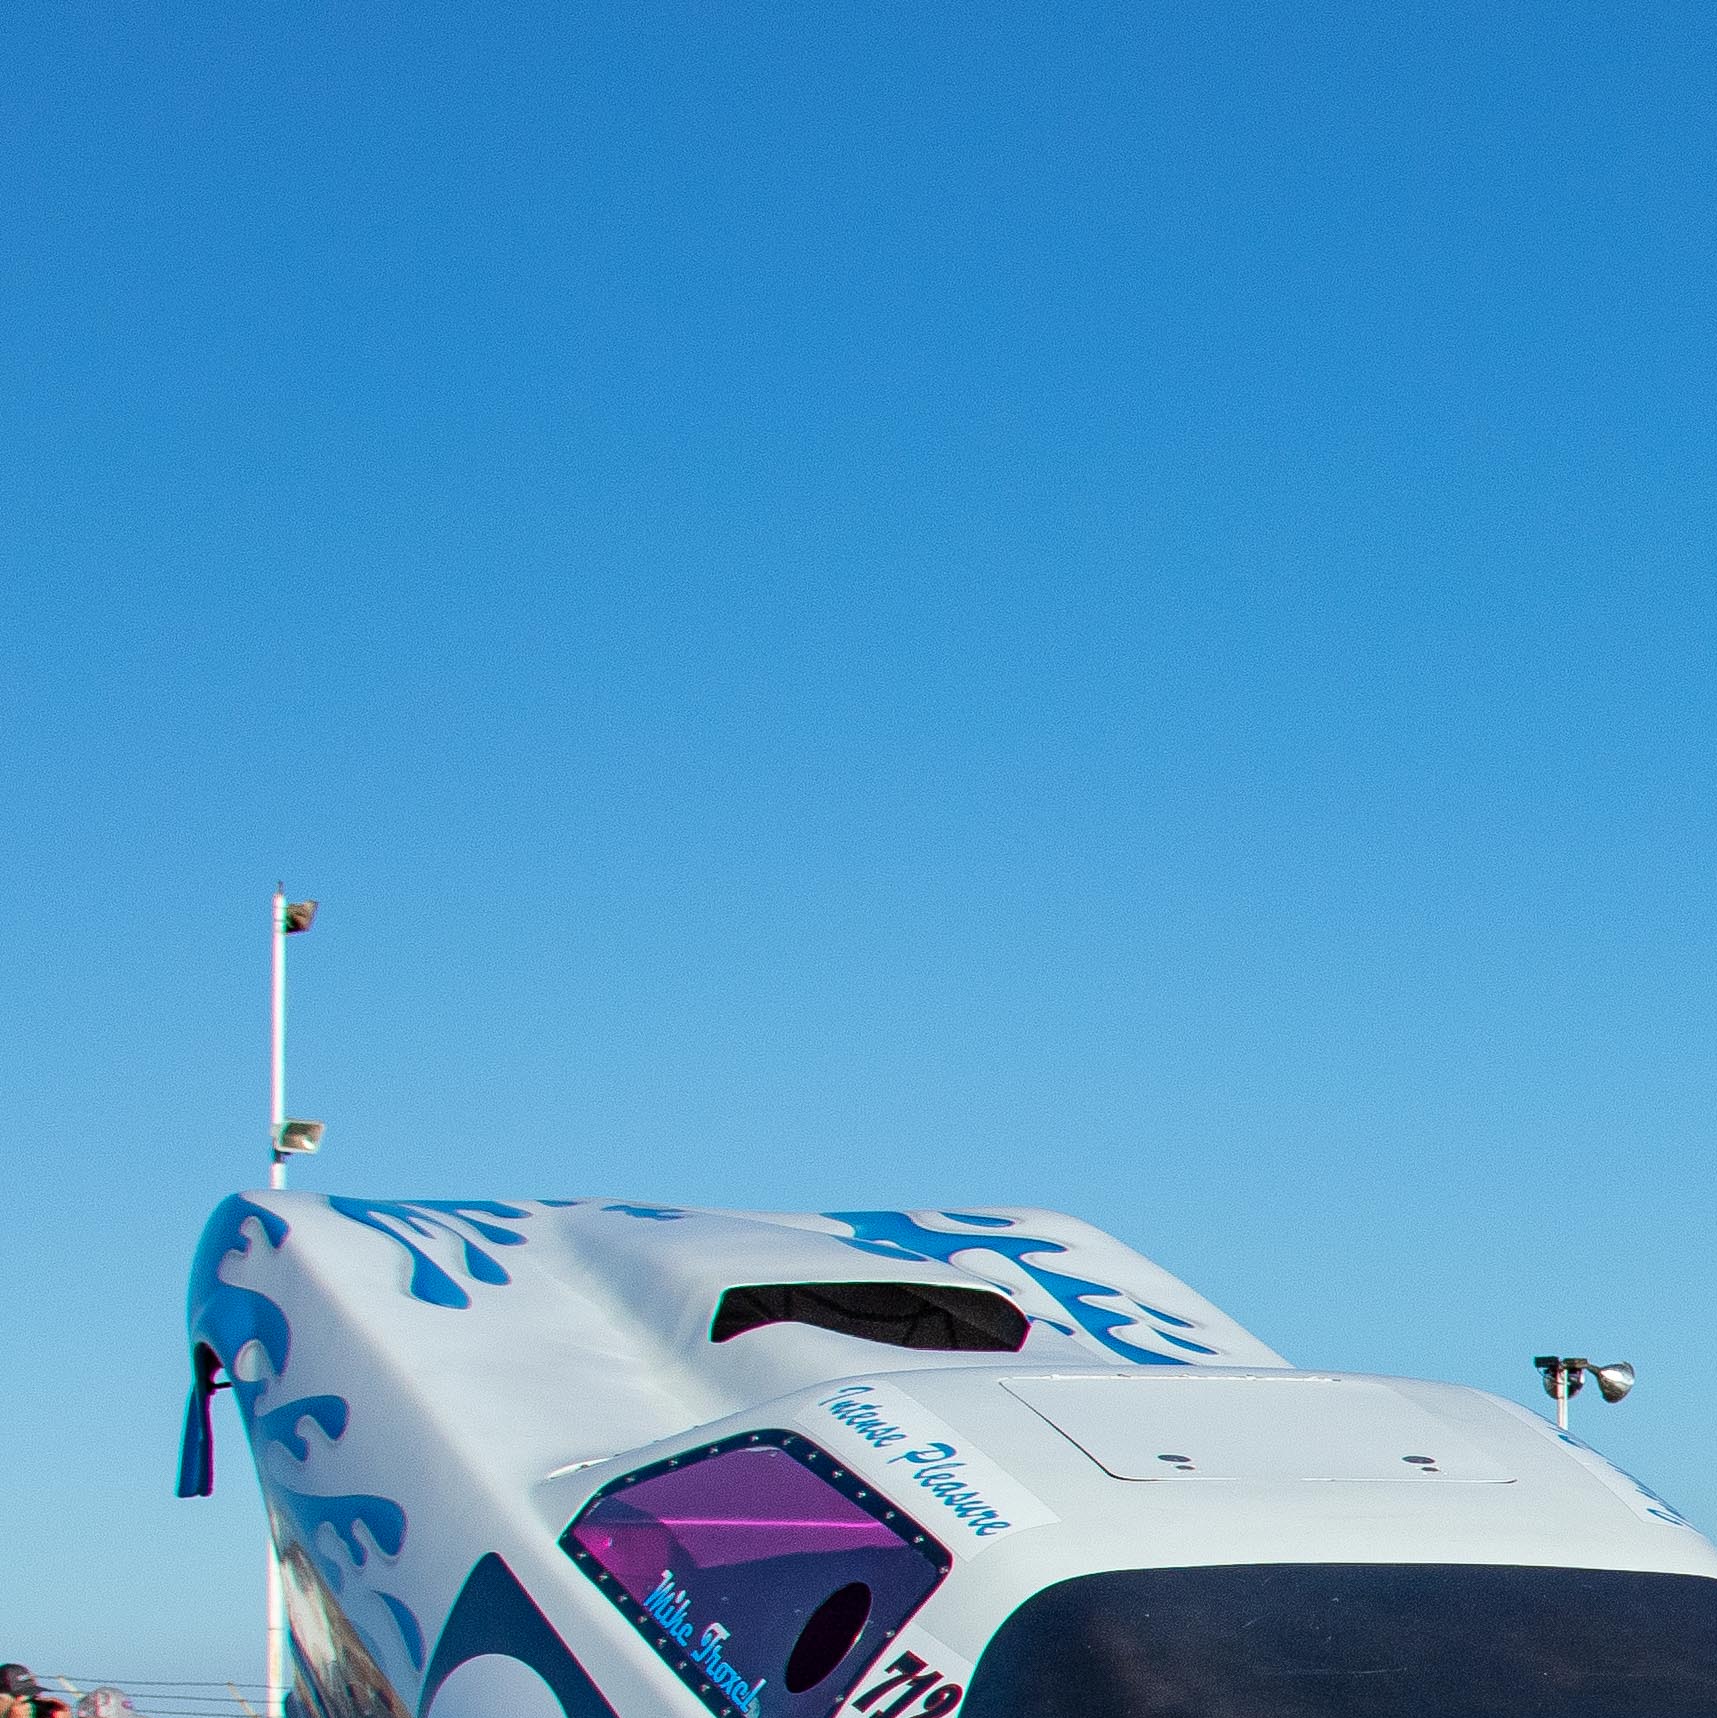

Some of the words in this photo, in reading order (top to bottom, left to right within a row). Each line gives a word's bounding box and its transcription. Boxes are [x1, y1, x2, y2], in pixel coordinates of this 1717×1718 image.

[818, 1386, 908, 1449] Intense
[886, 1441, 1015, 1538] Pleasure
[643, 1569, 692, 1646] Mike
[691, 1621, 767, 1715] Troxel
